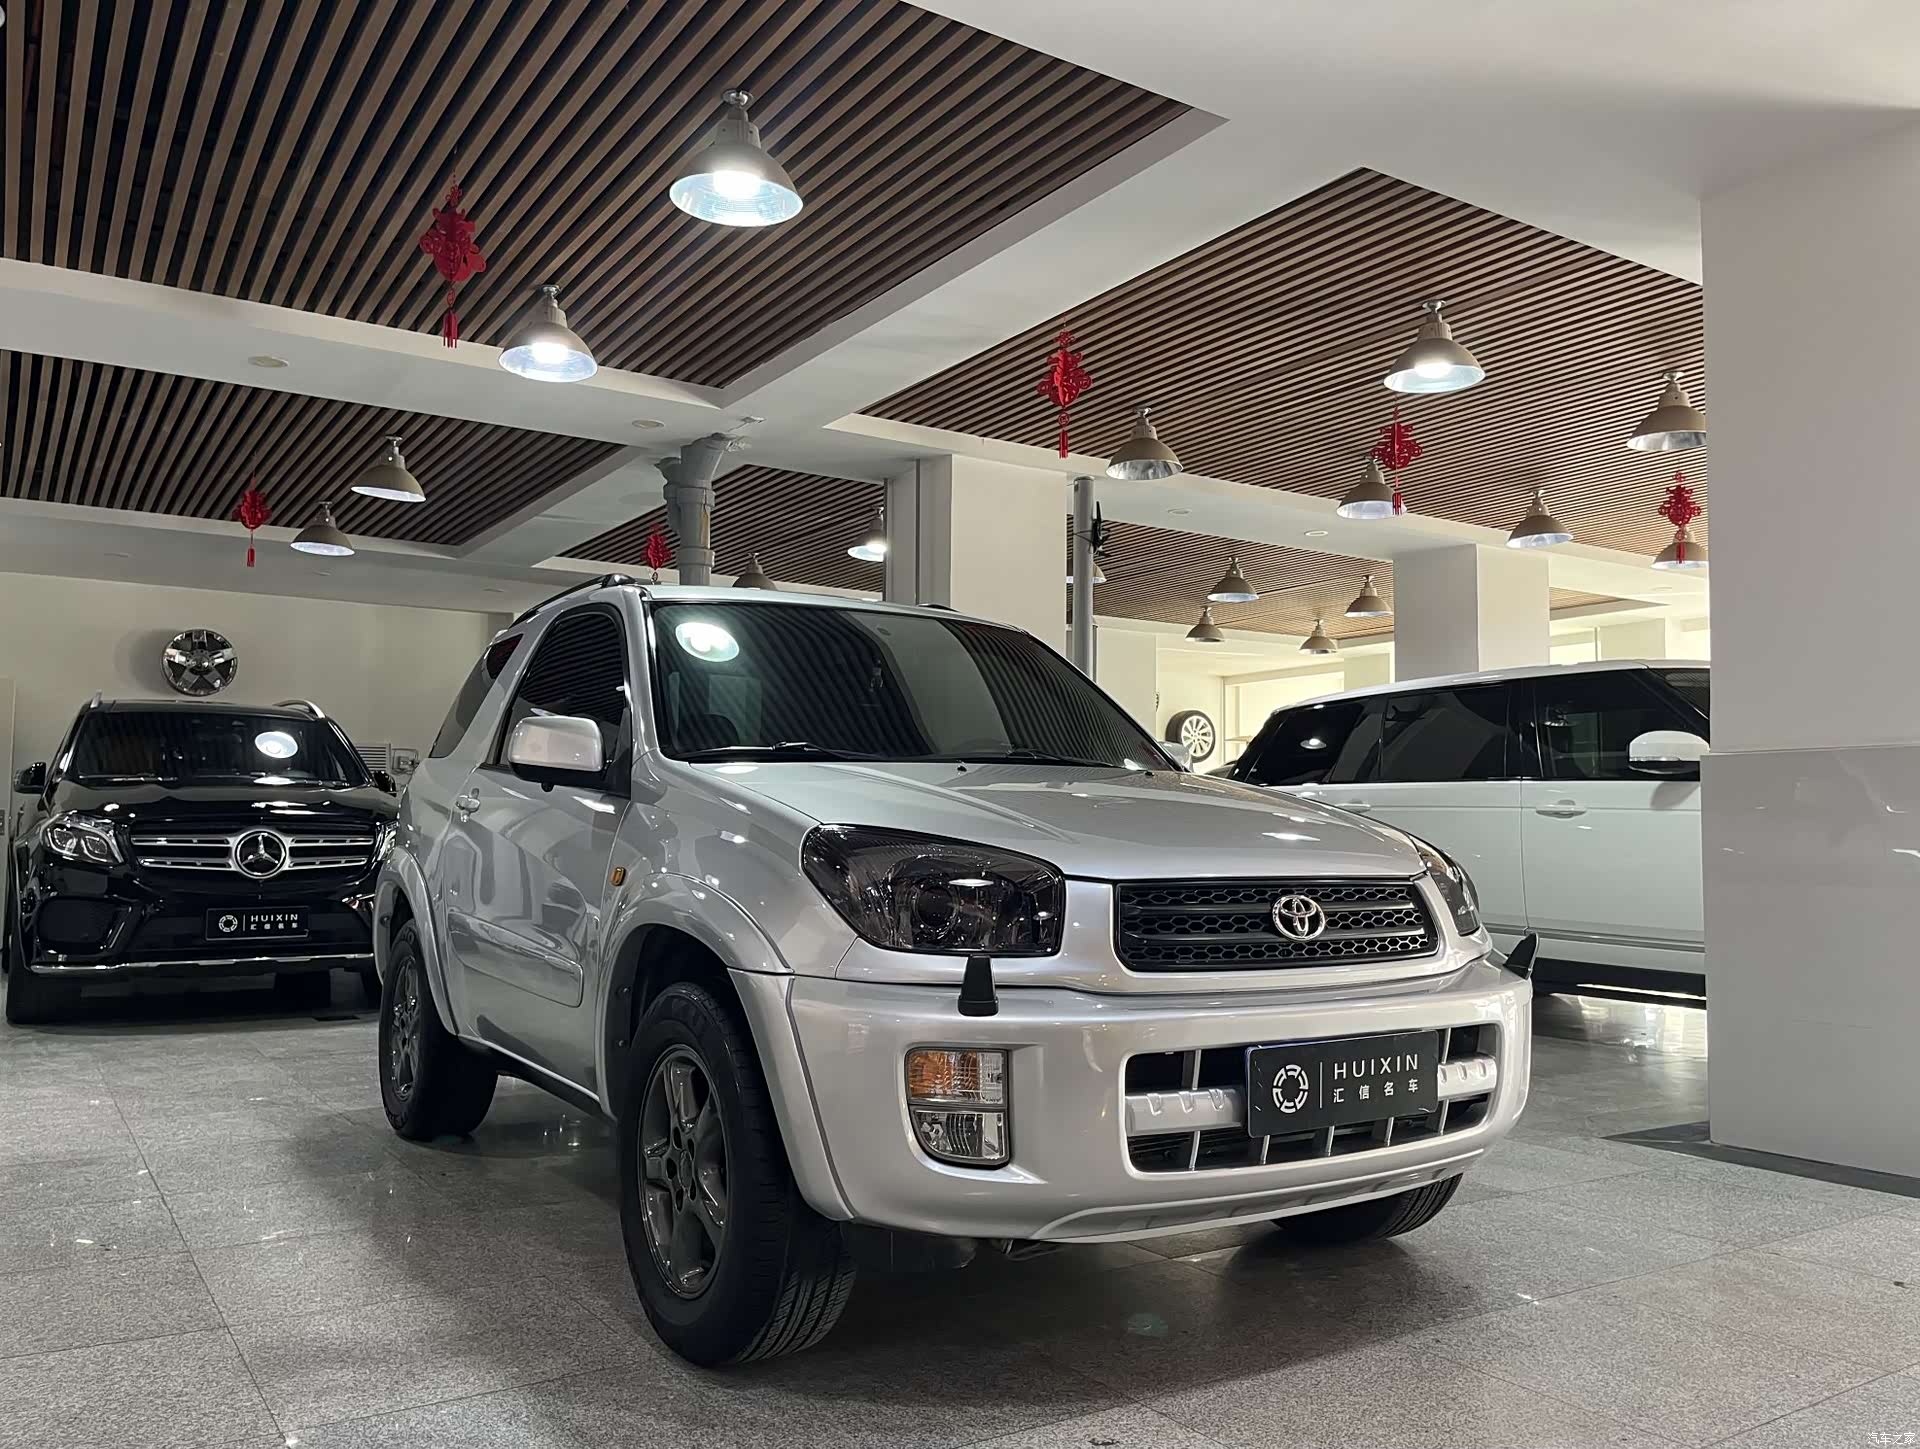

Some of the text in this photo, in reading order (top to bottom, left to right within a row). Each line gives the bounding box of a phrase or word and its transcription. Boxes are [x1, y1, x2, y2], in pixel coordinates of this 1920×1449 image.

[250, 913, 298, 922] HUIXIN
[1333, 1053, 1418, 1080] HUIXIN
[1333, 1078, 1419, 1103] 汇信名车
